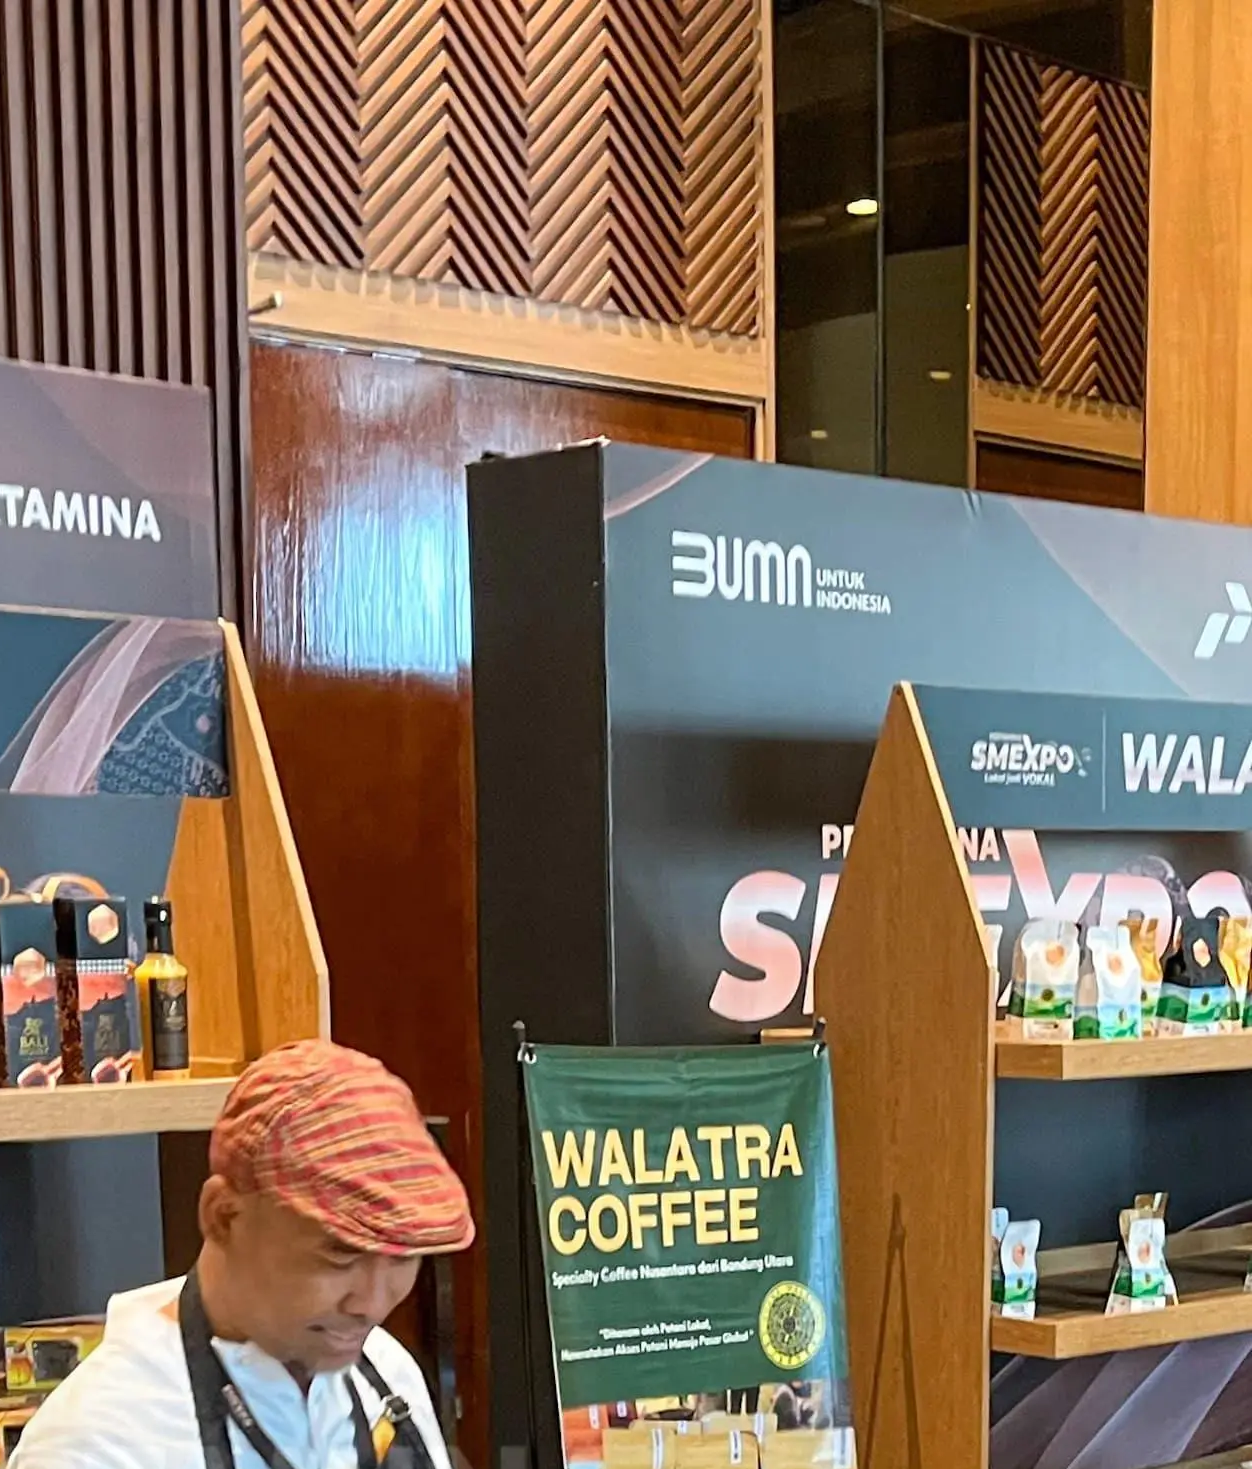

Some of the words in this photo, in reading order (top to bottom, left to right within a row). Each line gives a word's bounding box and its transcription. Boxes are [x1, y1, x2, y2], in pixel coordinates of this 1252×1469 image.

[815, 567, 865, 590] UNTUK
[815, 589, 892, 615] INDONESIA
[970, 734, 1074, 773] SMEXPO
[1022, 772, 1056, 787] VOKAL
[541, 1122, 804, 1189] WALATRA
[549, 1187, 761, 1256] COFFEE
[552, 1269, 599, 1290] Specialty
[601, 1266, 639, 1283] Coffee
[640, 1262, 697, 1280] Nusantara
[697, 1258, 720, 1275] dari
[720, 1256, 764, 1273] Bandung
[764, 1254, 794, 1268] Utara
